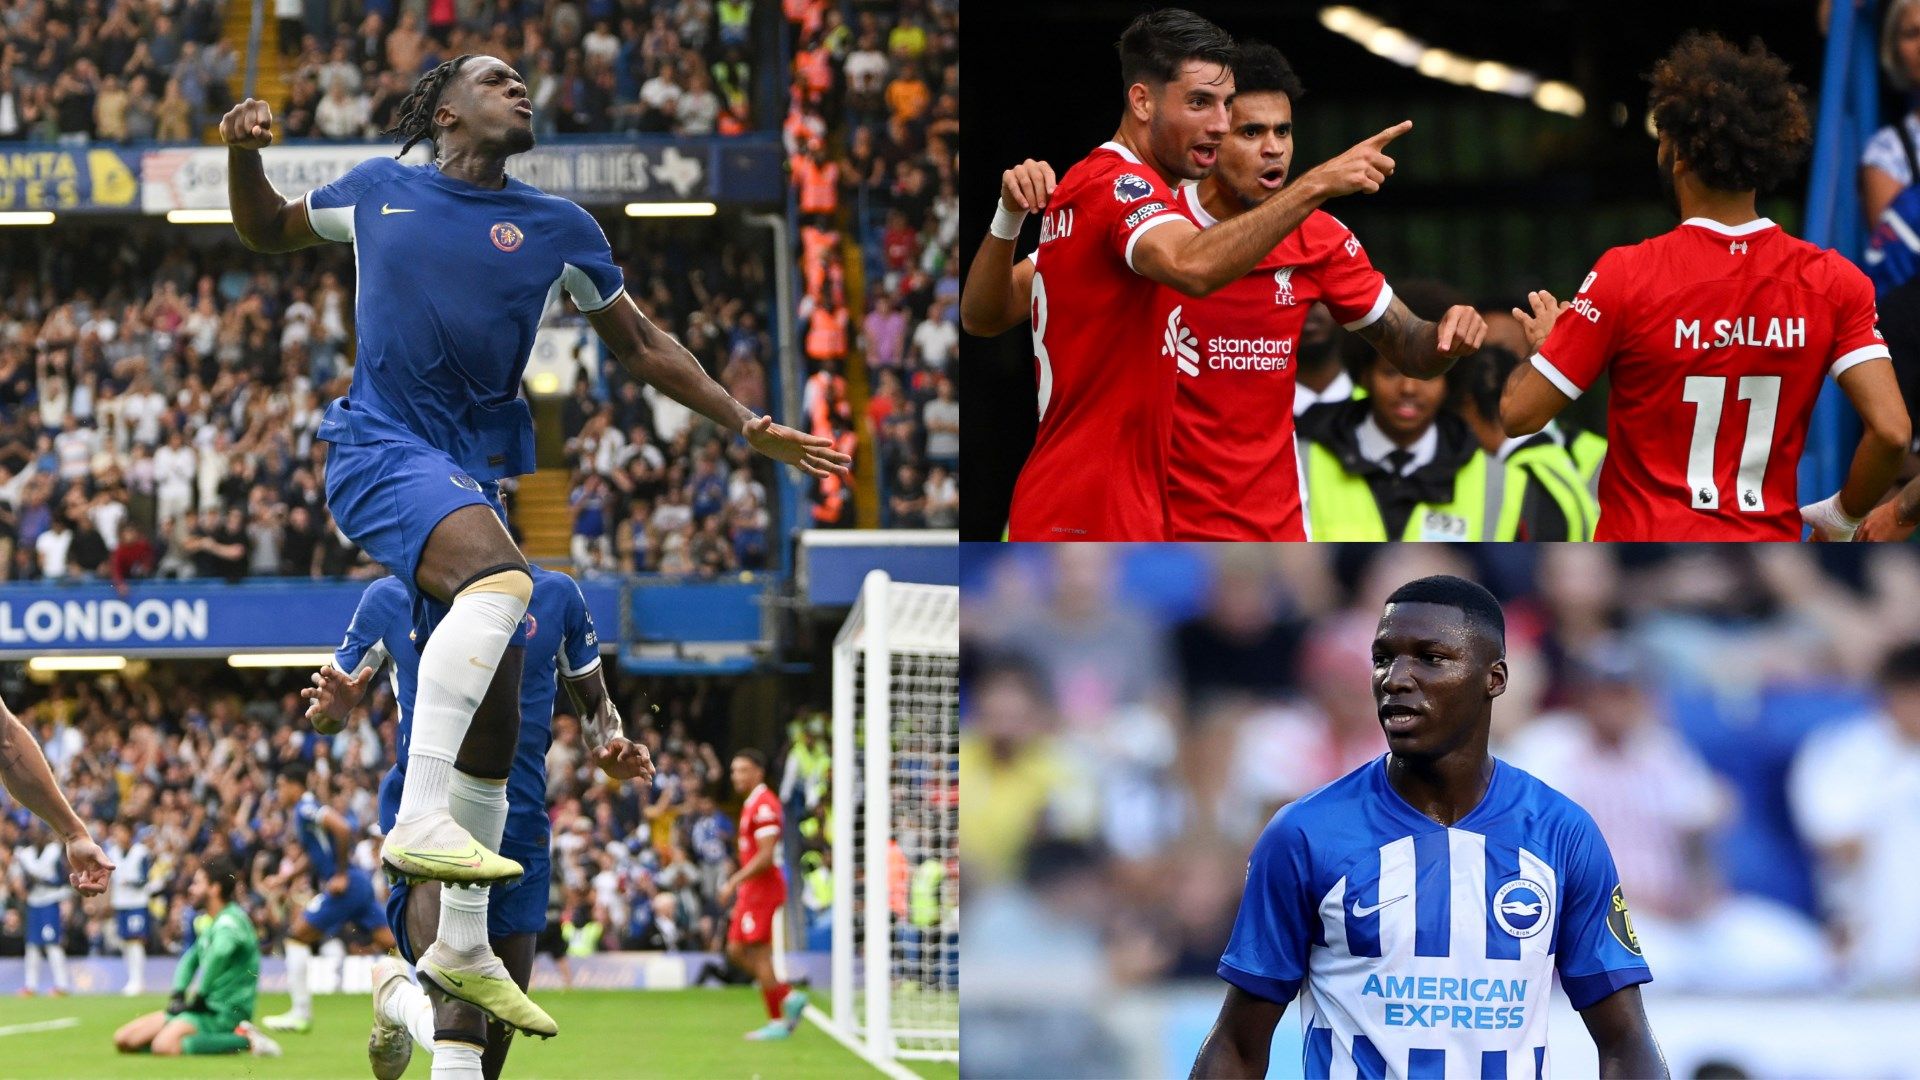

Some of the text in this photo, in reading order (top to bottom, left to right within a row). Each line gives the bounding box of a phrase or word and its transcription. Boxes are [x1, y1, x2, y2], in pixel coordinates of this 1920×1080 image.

[576, 153, 649, 193] BLUES
[1137, 202, 1163, 216] room
[1208, 335, 1292, 354] standard
[1682, 375, 1782, 512] 11
[0, 599, 209, 643] LONDON
[1361, 973, 1528, 1002] AMERICAN
[1384, 1003, 1525, 1030] EXPRESS
